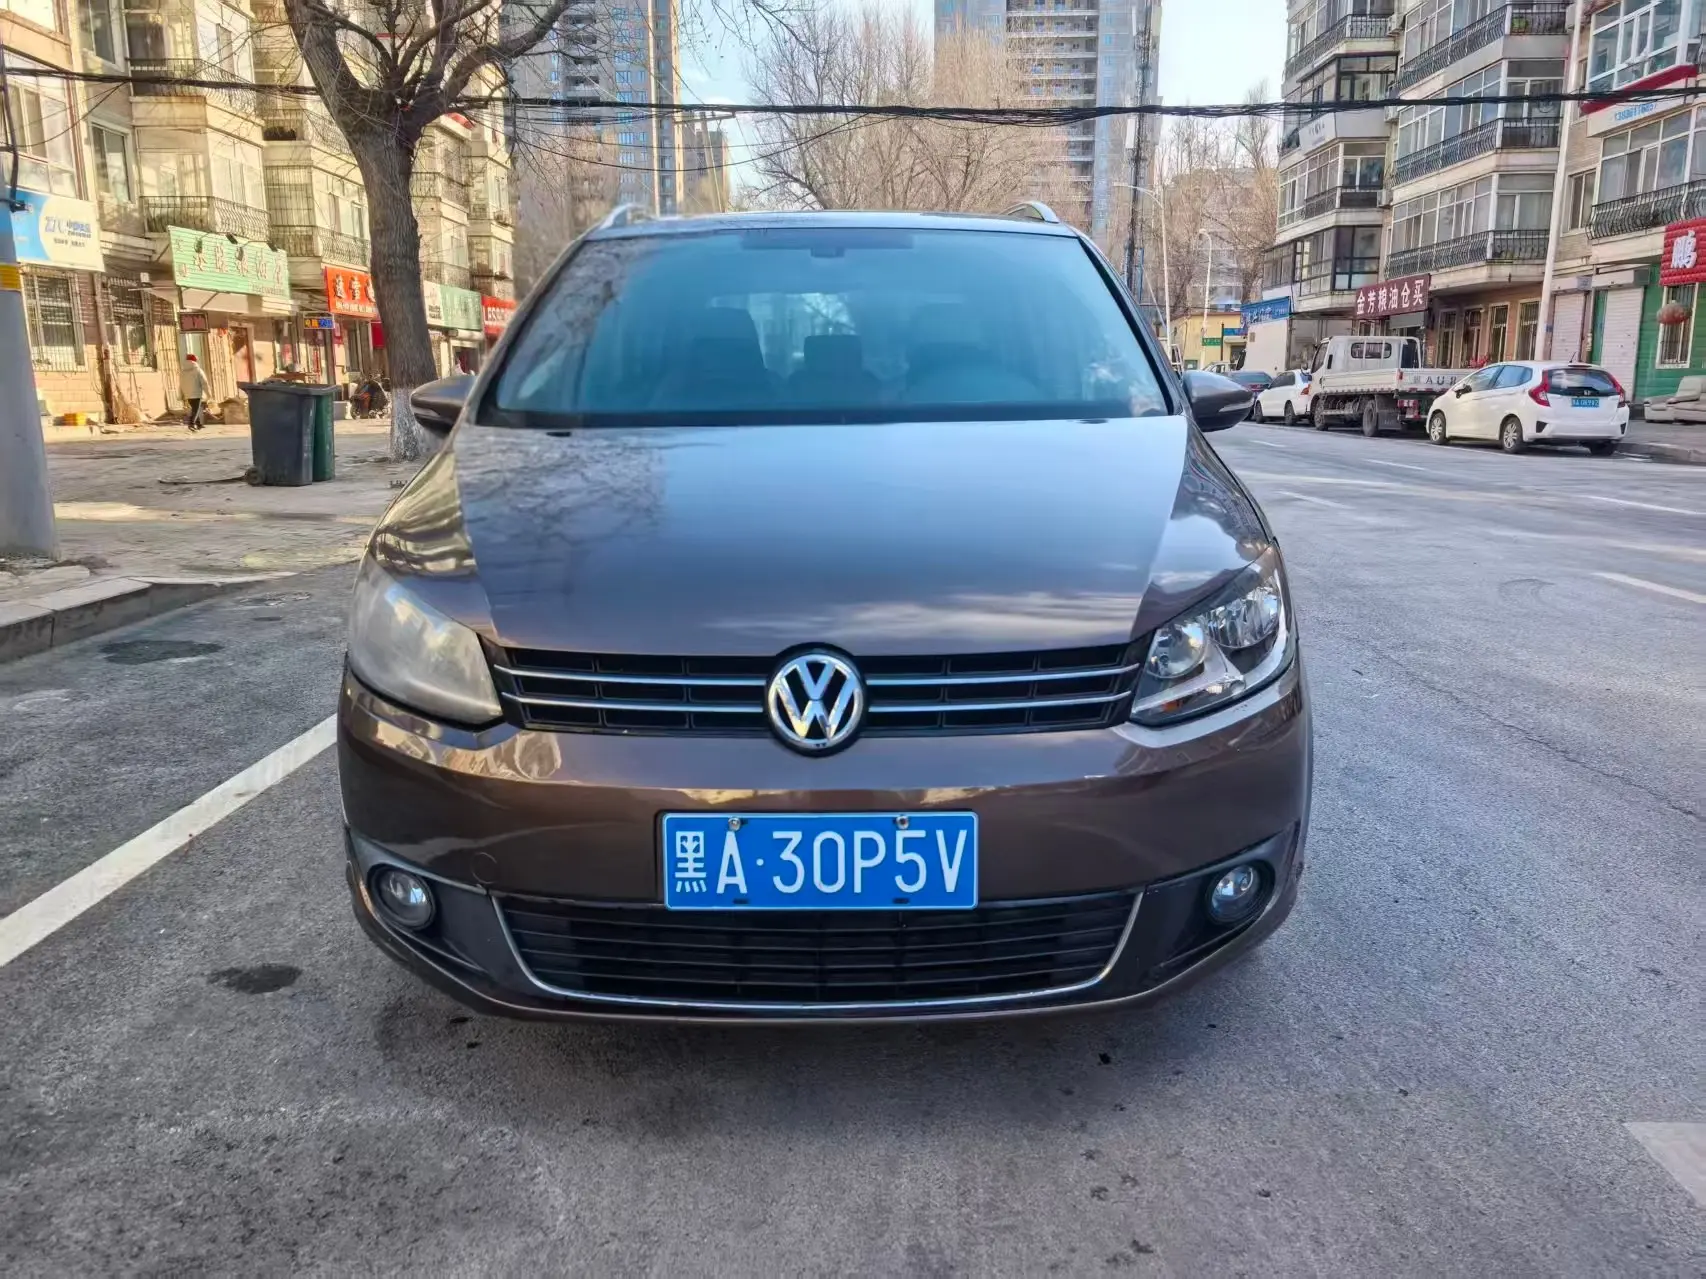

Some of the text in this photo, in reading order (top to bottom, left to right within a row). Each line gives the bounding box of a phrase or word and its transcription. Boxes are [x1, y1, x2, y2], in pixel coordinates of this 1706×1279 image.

[1356, 279, 1425, 315] 金芳粮油仓买
